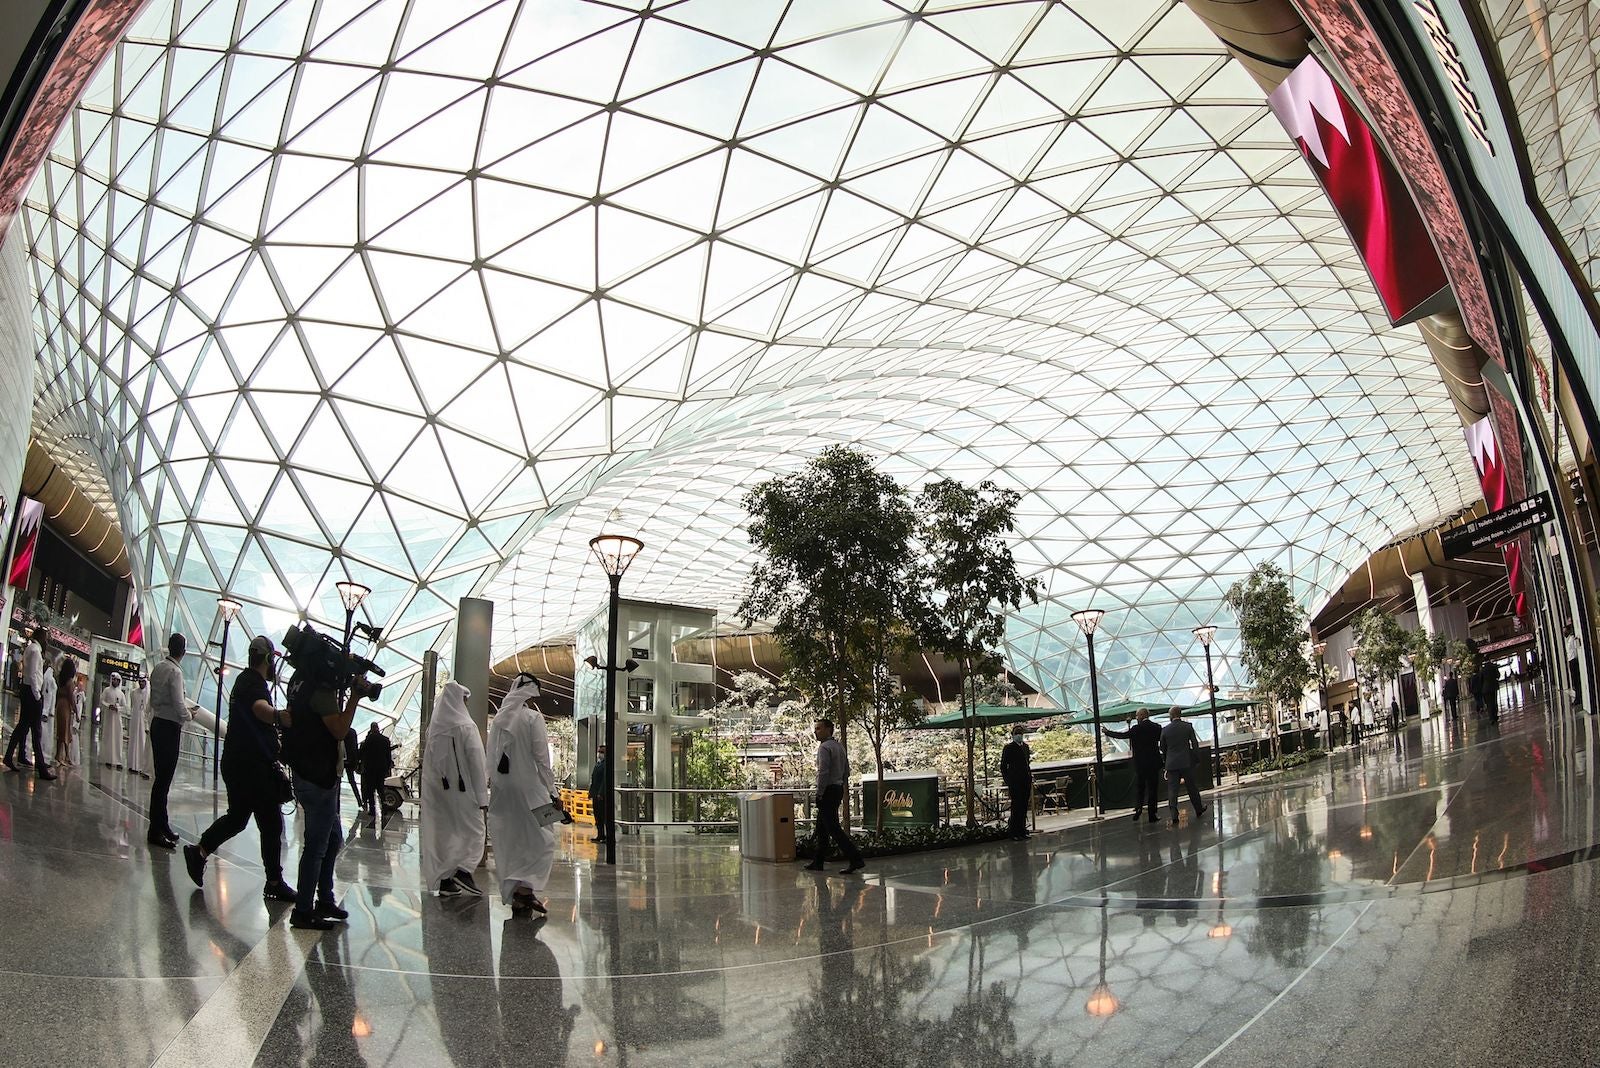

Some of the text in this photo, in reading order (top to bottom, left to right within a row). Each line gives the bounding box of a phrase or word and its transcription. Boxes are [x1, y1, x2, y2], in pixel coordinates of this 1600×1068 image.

[1478, 519, 1493, 527] Toilets
[1472, 535, 1491, 546] Smoking
[1491, 530, 1504, 538] Room
